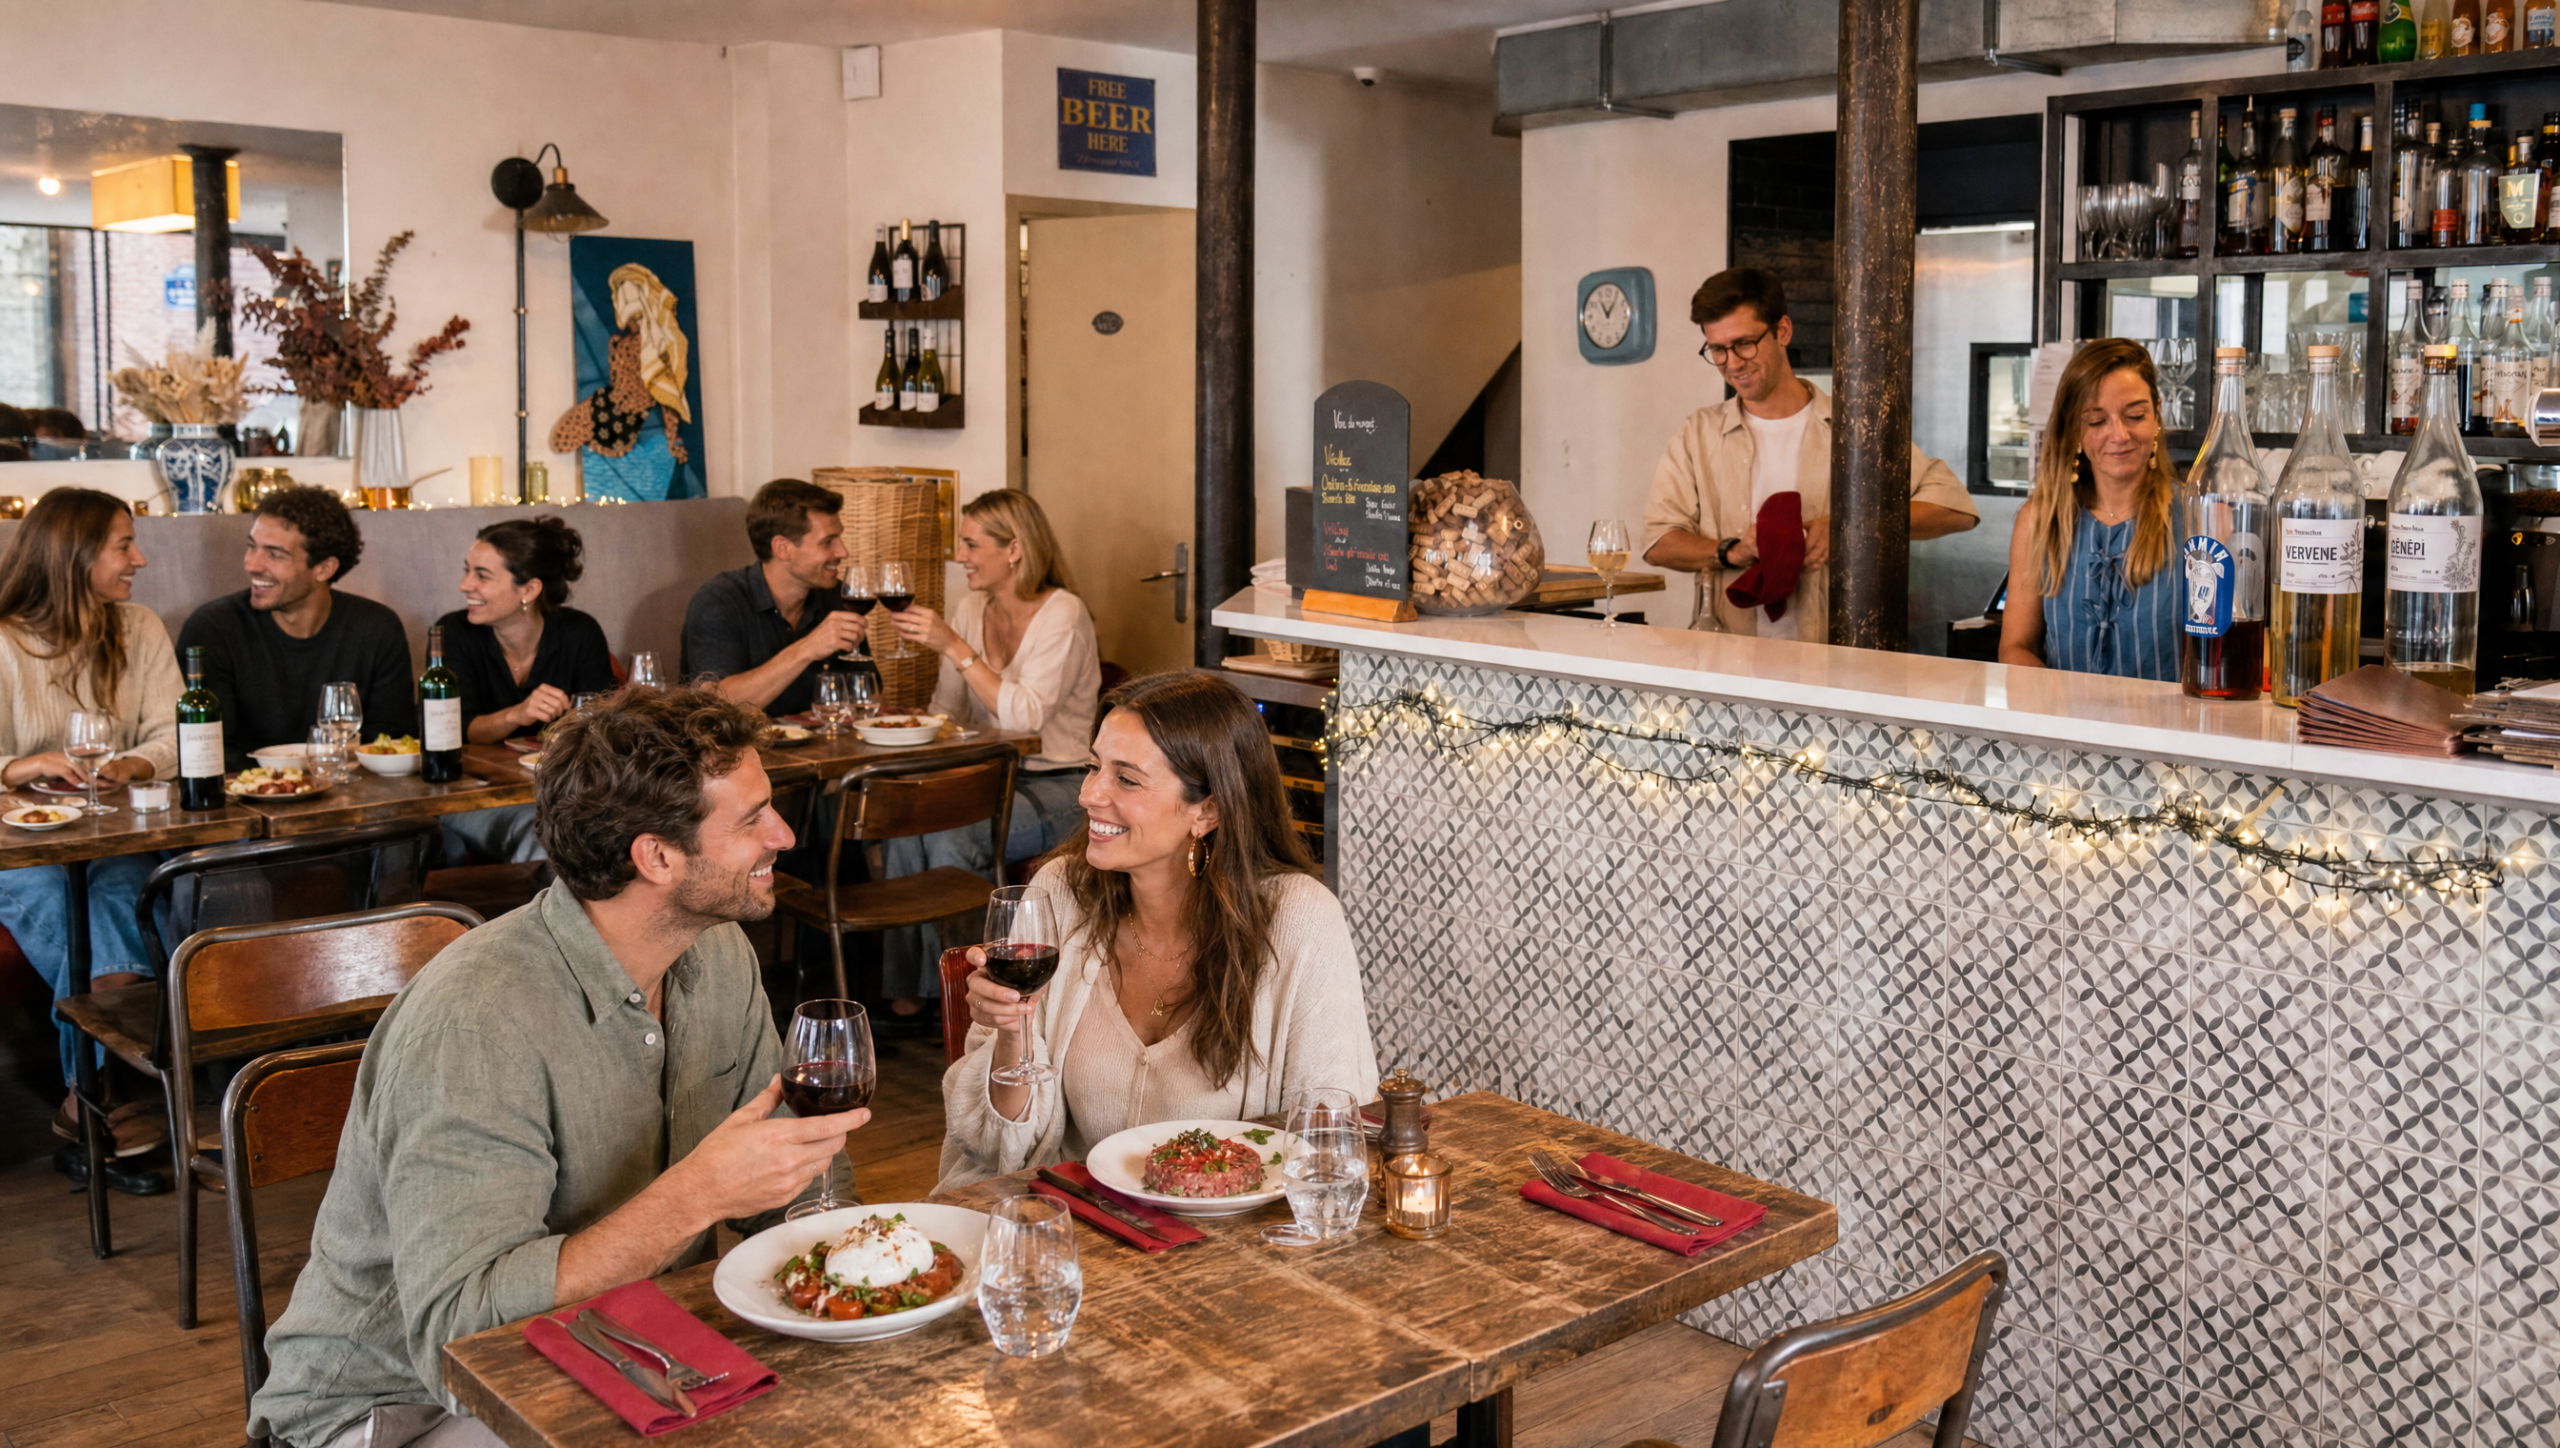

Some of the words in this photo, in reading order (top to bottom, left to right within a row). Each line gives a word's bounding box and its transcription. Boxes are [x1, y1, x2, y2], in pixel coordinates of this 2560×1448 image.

[1088, 79, 1126, 99] FREE
[1061, 97, 1152, 134] BEER
[1088, 132, 1128, 153] HERE
[2285, 545, 2337, 561] VERVENE
